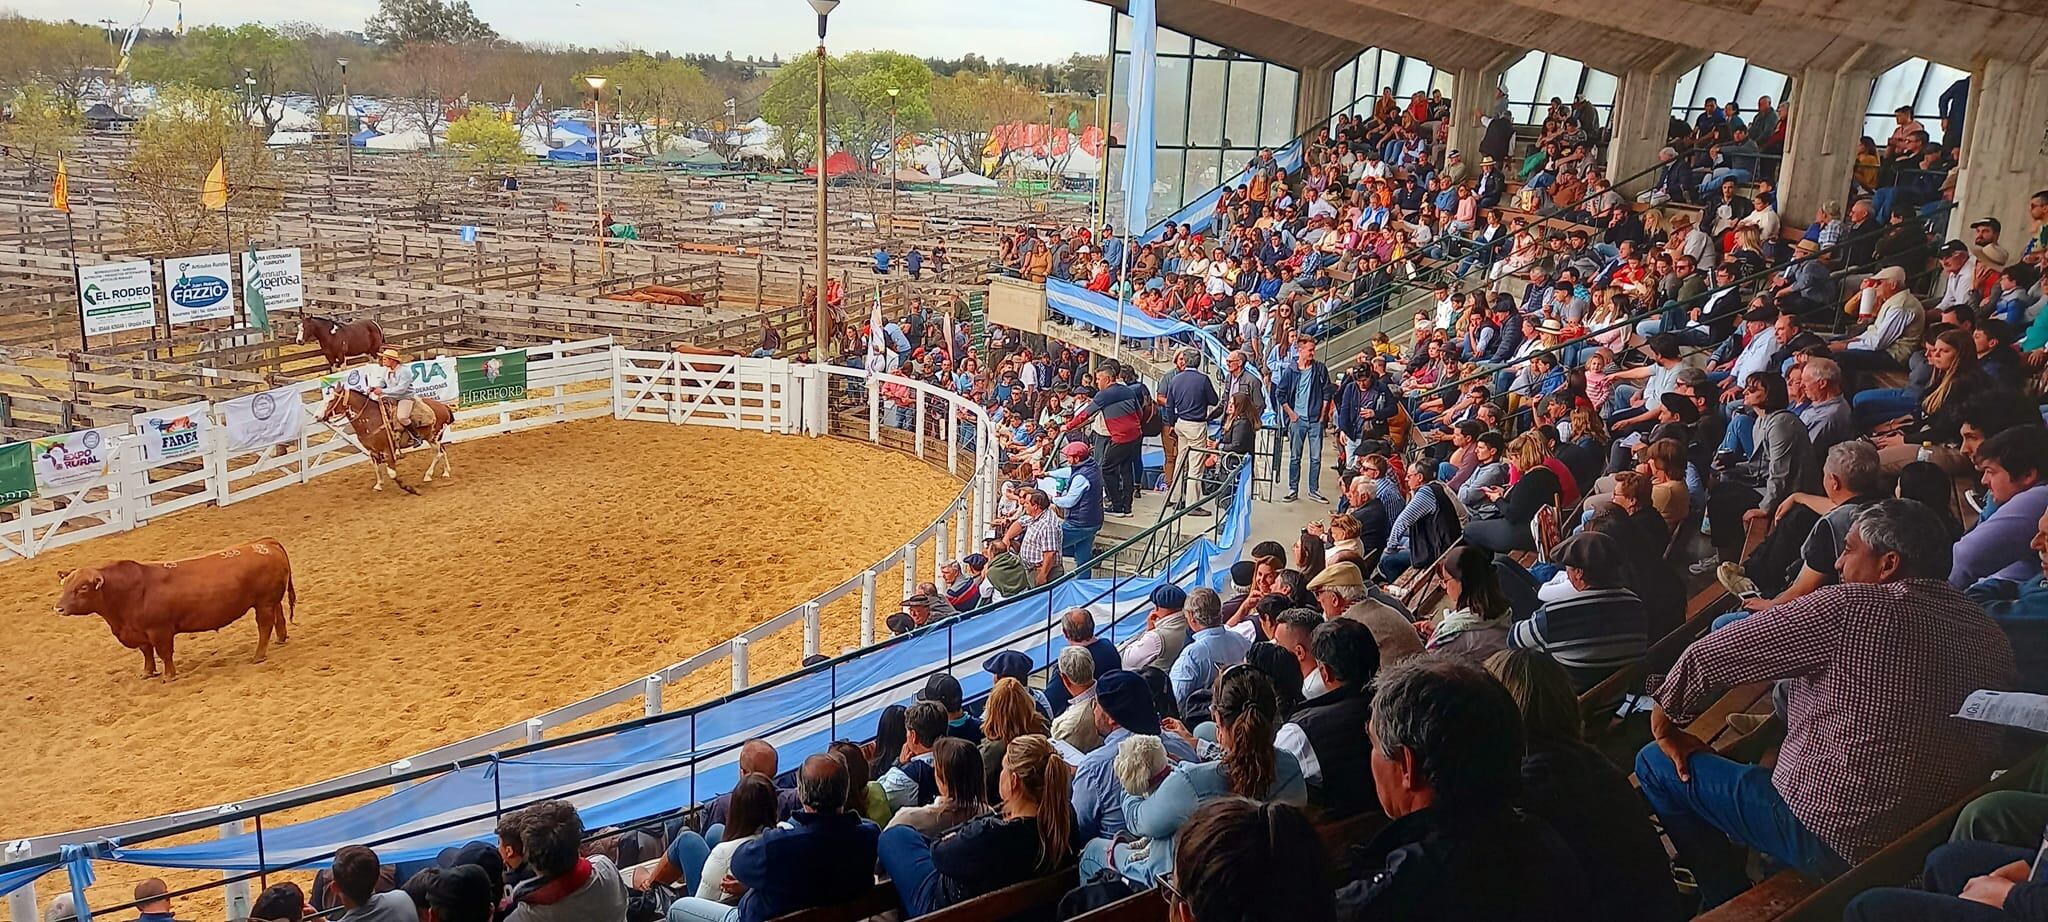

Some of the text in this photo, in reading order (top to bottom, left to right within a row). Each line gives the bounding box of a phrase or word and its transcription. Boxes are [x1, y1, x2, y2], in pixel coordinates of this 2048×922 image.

[96, 291, 110, 301] EL
[112, 286, 151, 299] RODEO
[173, 285, 223, 303] FAZZIO
[462, 385, 524, 404] HEREFORD
[63, 449, 92, 461] EXPO
[63, 456, 101, 469] RURAL
